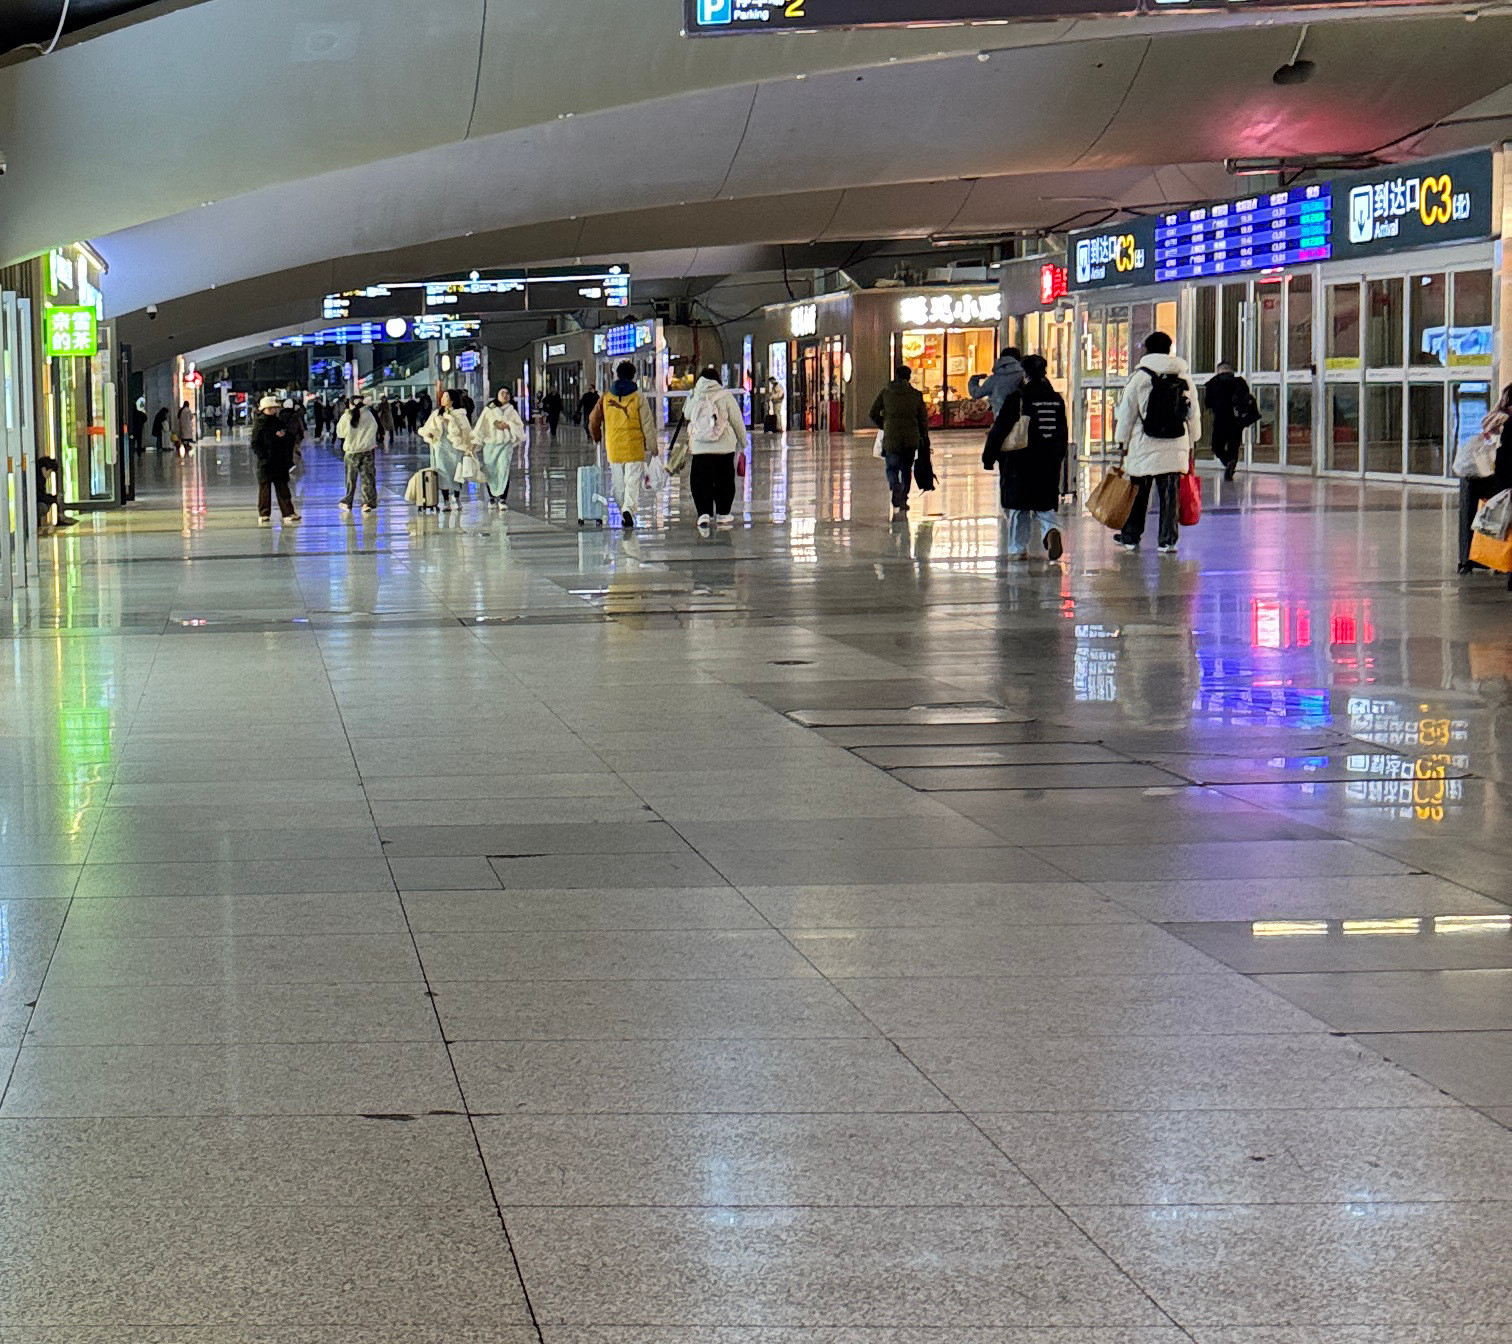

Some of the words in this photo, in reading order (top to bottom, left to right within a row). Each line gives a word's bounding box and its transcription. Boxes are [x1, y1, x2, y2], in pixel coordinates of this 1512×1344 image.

[734, 9, 769, 21] Parking
[1374, 177, 1420, 218] 到达口
[1420, 174, 1452, 226] C3
[1090, 235, 1117, 264] 到达口
[1116, 234, 1135, 272] C3
